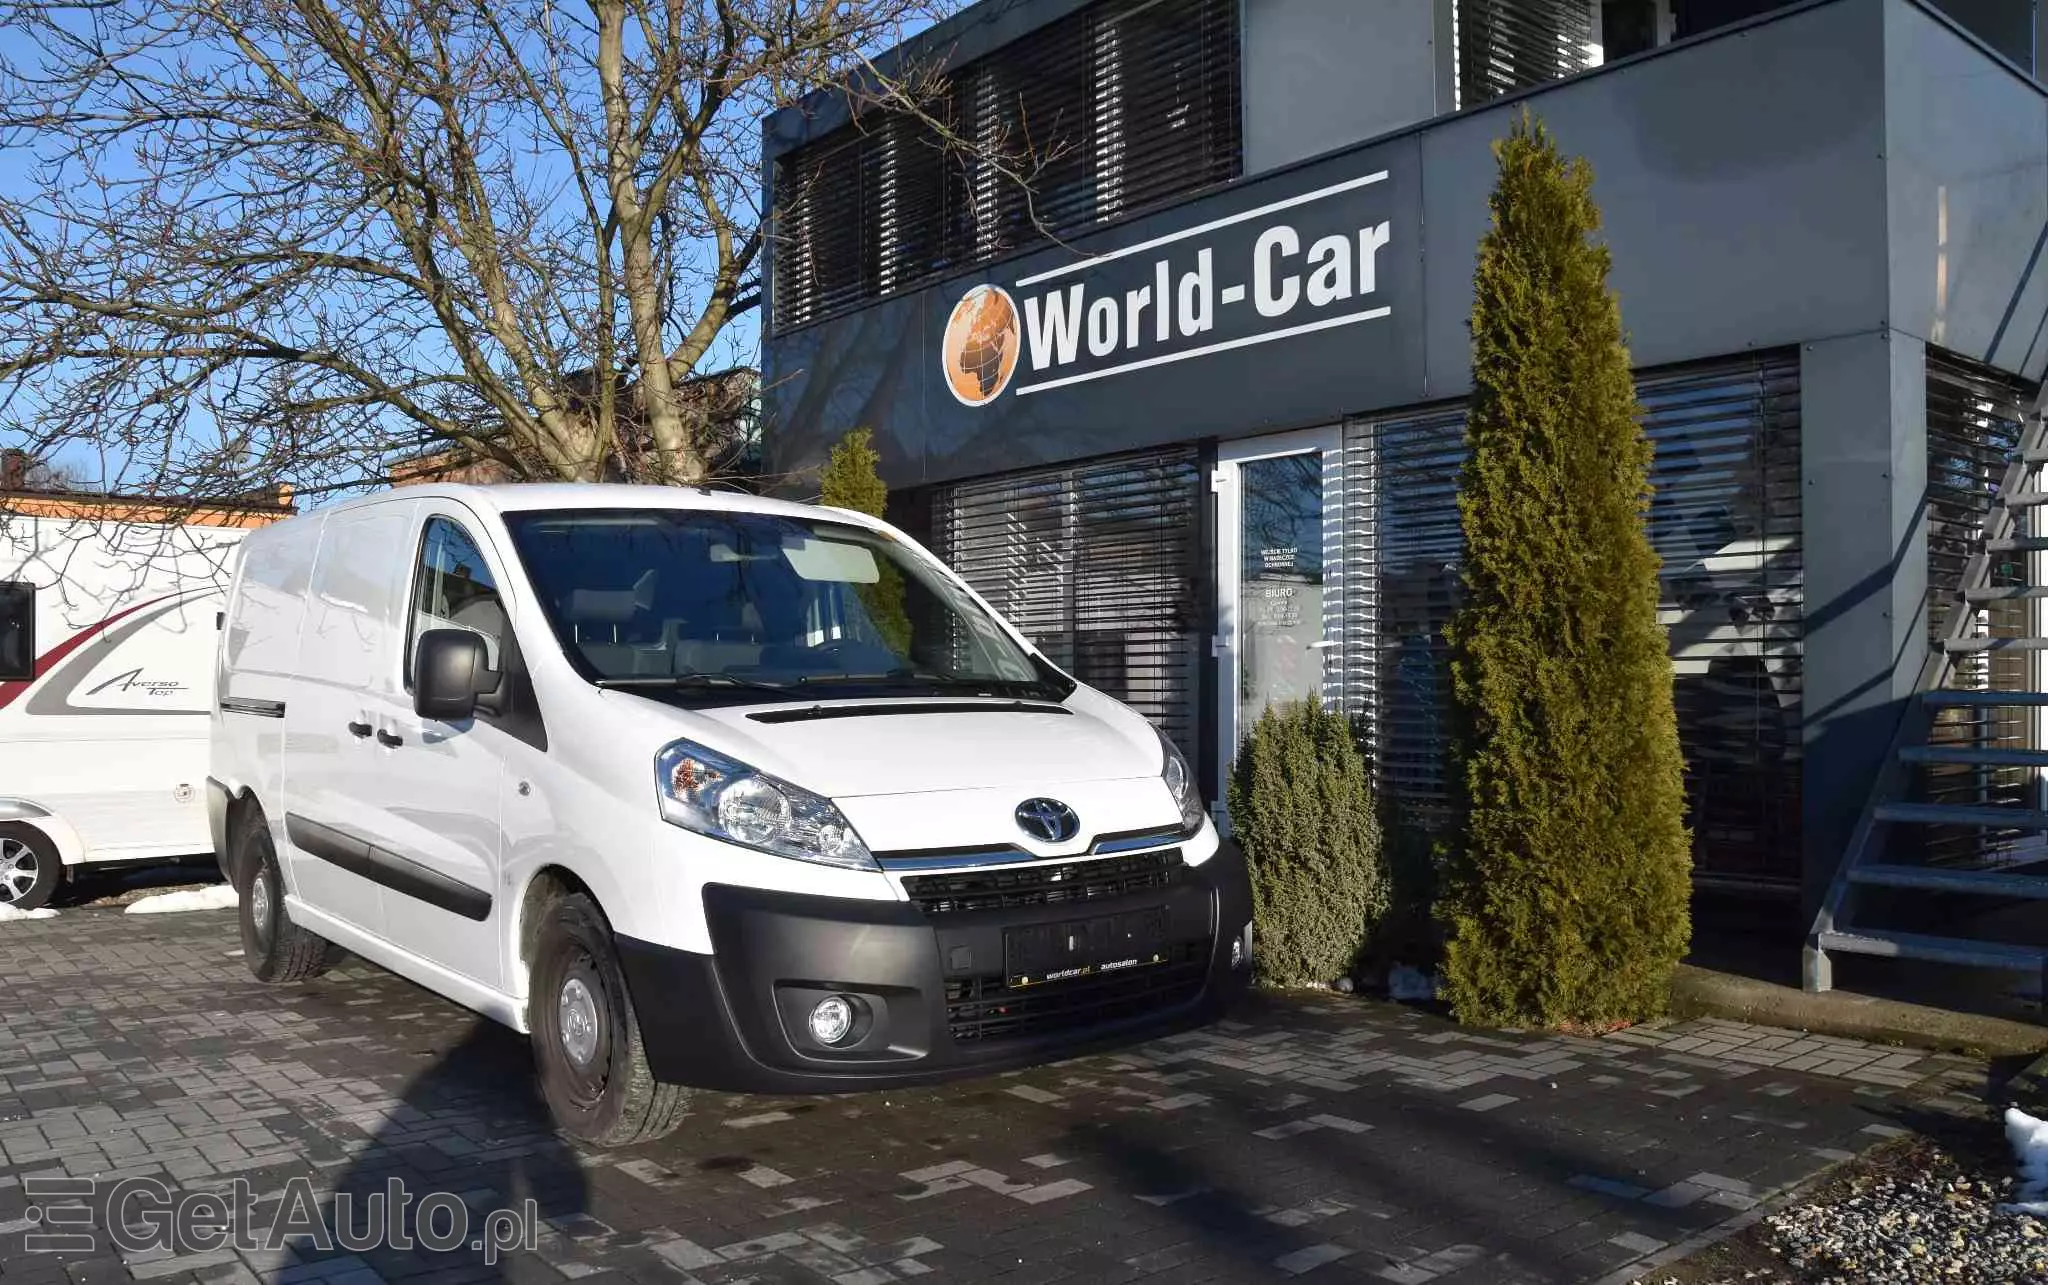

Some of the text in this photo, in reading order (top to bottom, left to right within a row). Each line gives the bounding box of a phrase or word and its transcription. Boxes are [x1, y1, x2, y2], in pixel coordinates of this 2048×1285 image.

[1023, 220, 1391, 372] World-Car
[1265, 588, 1293, 598] BIURO
[86, 667, 179, 695] Averso
[146, 687, 187, 696] Top
[1046, 959, 1138, 980] worldcar.pl autosalon
